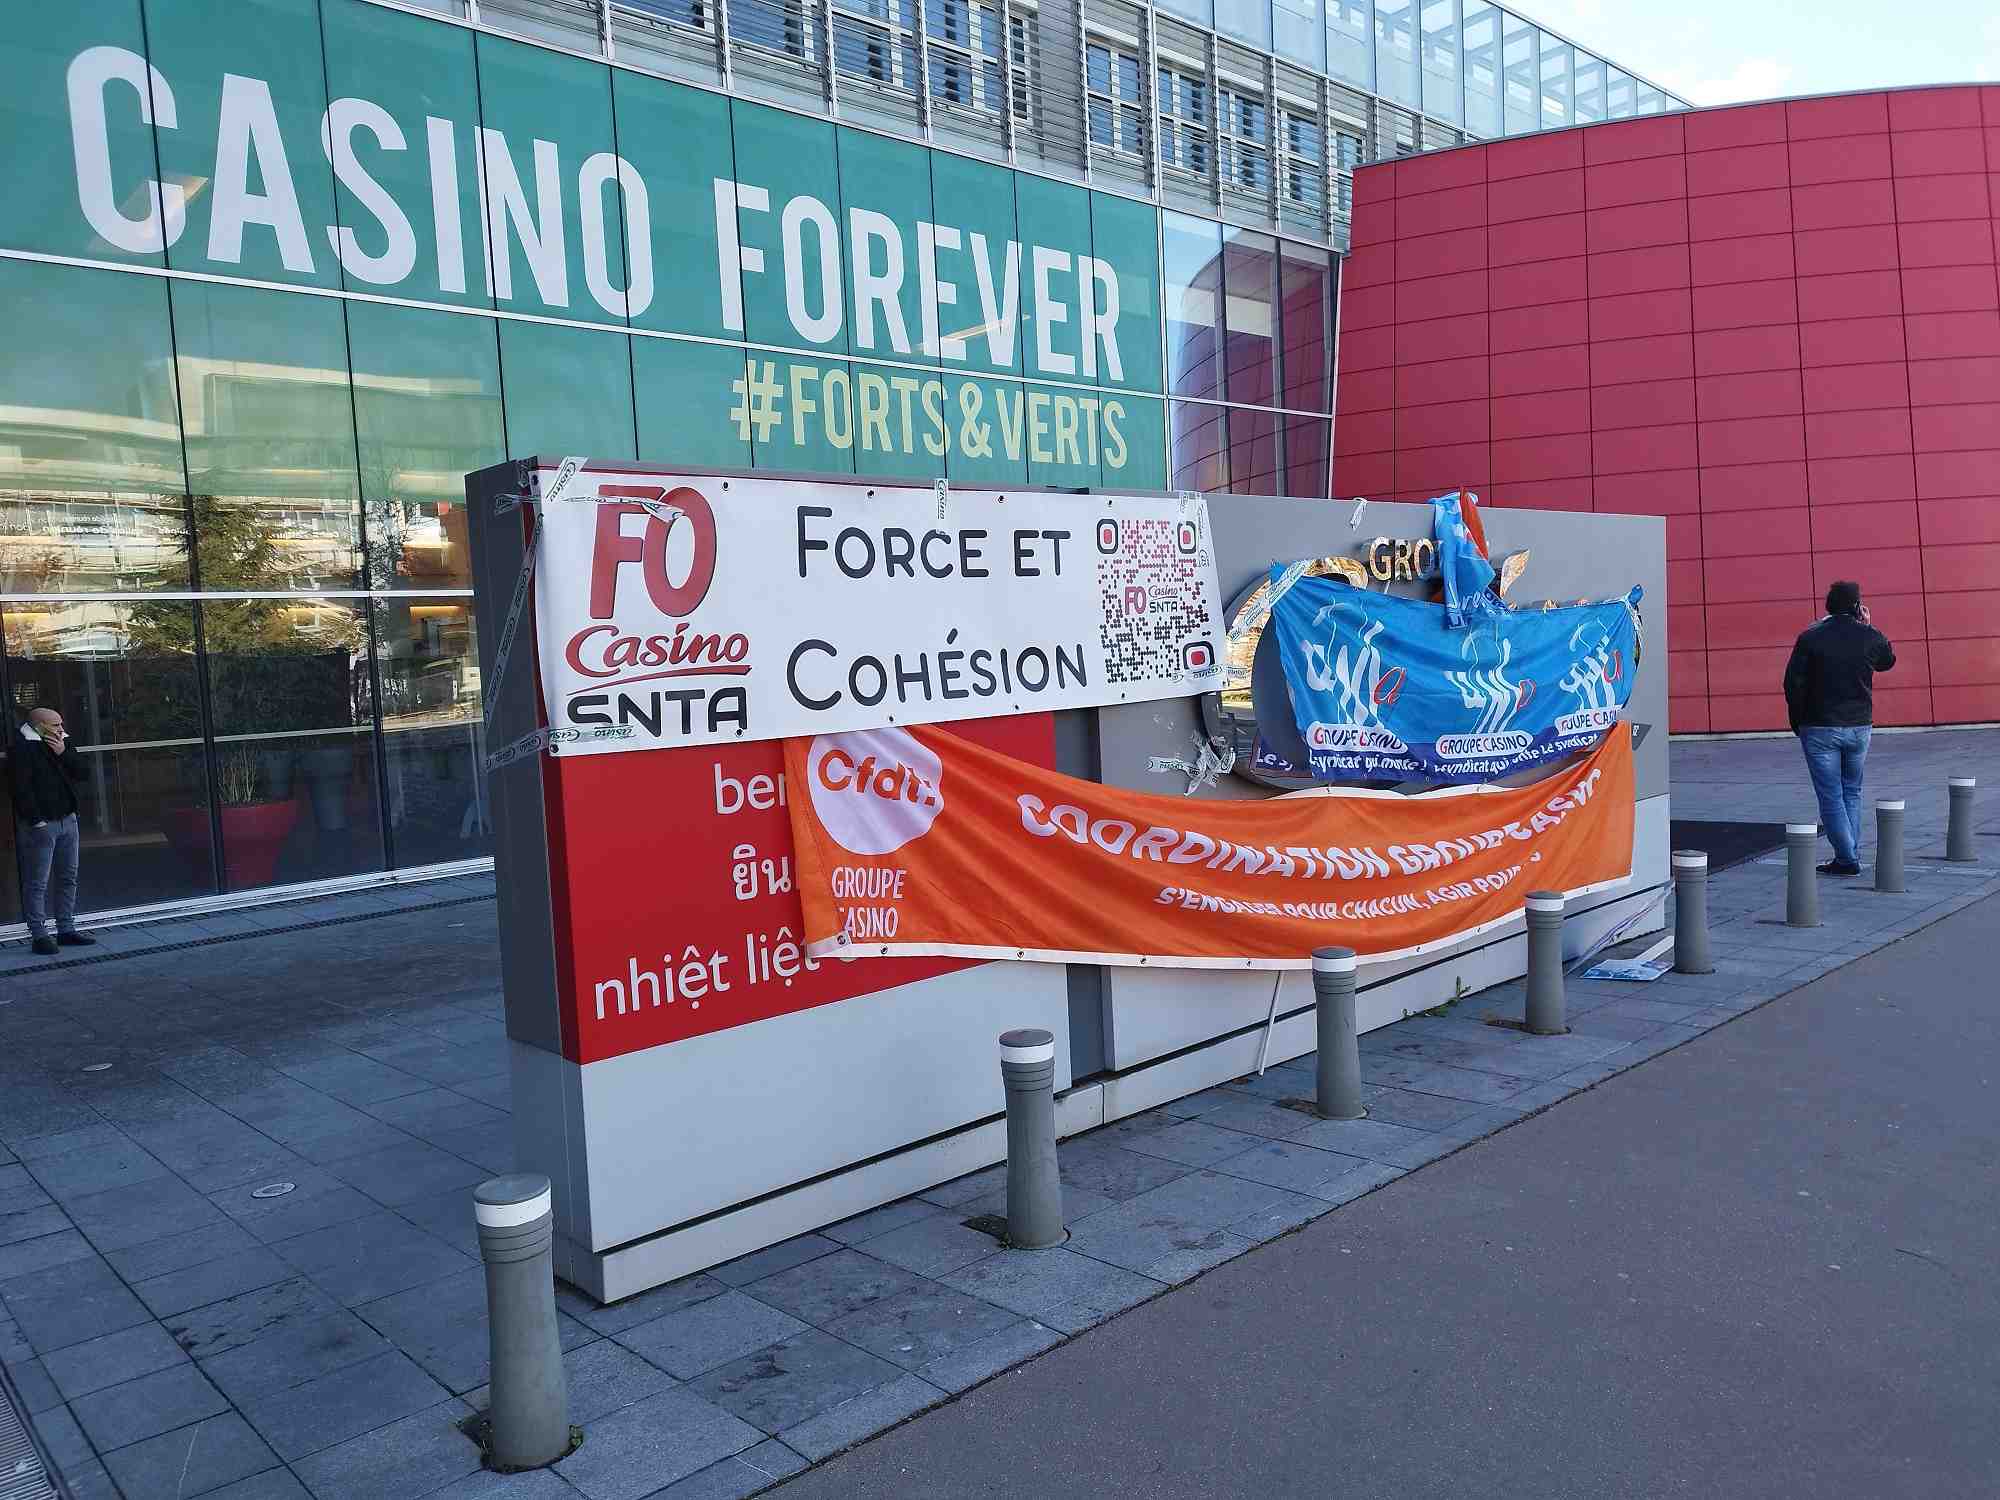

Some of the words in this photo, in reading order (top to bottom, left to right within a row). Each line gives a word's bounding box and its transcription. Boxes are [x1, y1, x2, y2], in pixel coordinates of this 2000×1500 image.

[66, 46, 655, 318] CASINO
[714, 177, 1124, 382] FOREVER
[729, 359, 1129, 470] #FORTS&VERTS
[589, 484, 718, 620] FO
[797, 506, 989, 579] FORCE
[1013, 529, 1071, 577] ET
[1369, 536, 1438, 582] GRO
[1125, 586, 1146, 615] FO
[1148, 584, 1178, 599] Casino
[1149, 601, 1178, 613] SNTA
[565, 622, 749, 678] Casino
[786, 628, 1089, 710] COHÉSION
[566, 686, 748, 738] SNTA
[1440, 738, 1483, 755] GROUPE
[1483, 734, 1528, 752] CASINO
[1017, 794, 1389, 880] COORDINATION
[733, 844, 800, 901] ยิน
[831, 866, 907, 899] GROUPE
[839, 906, 899, 938] ASINO
[595, 945, 731, 1020] nhiệt
